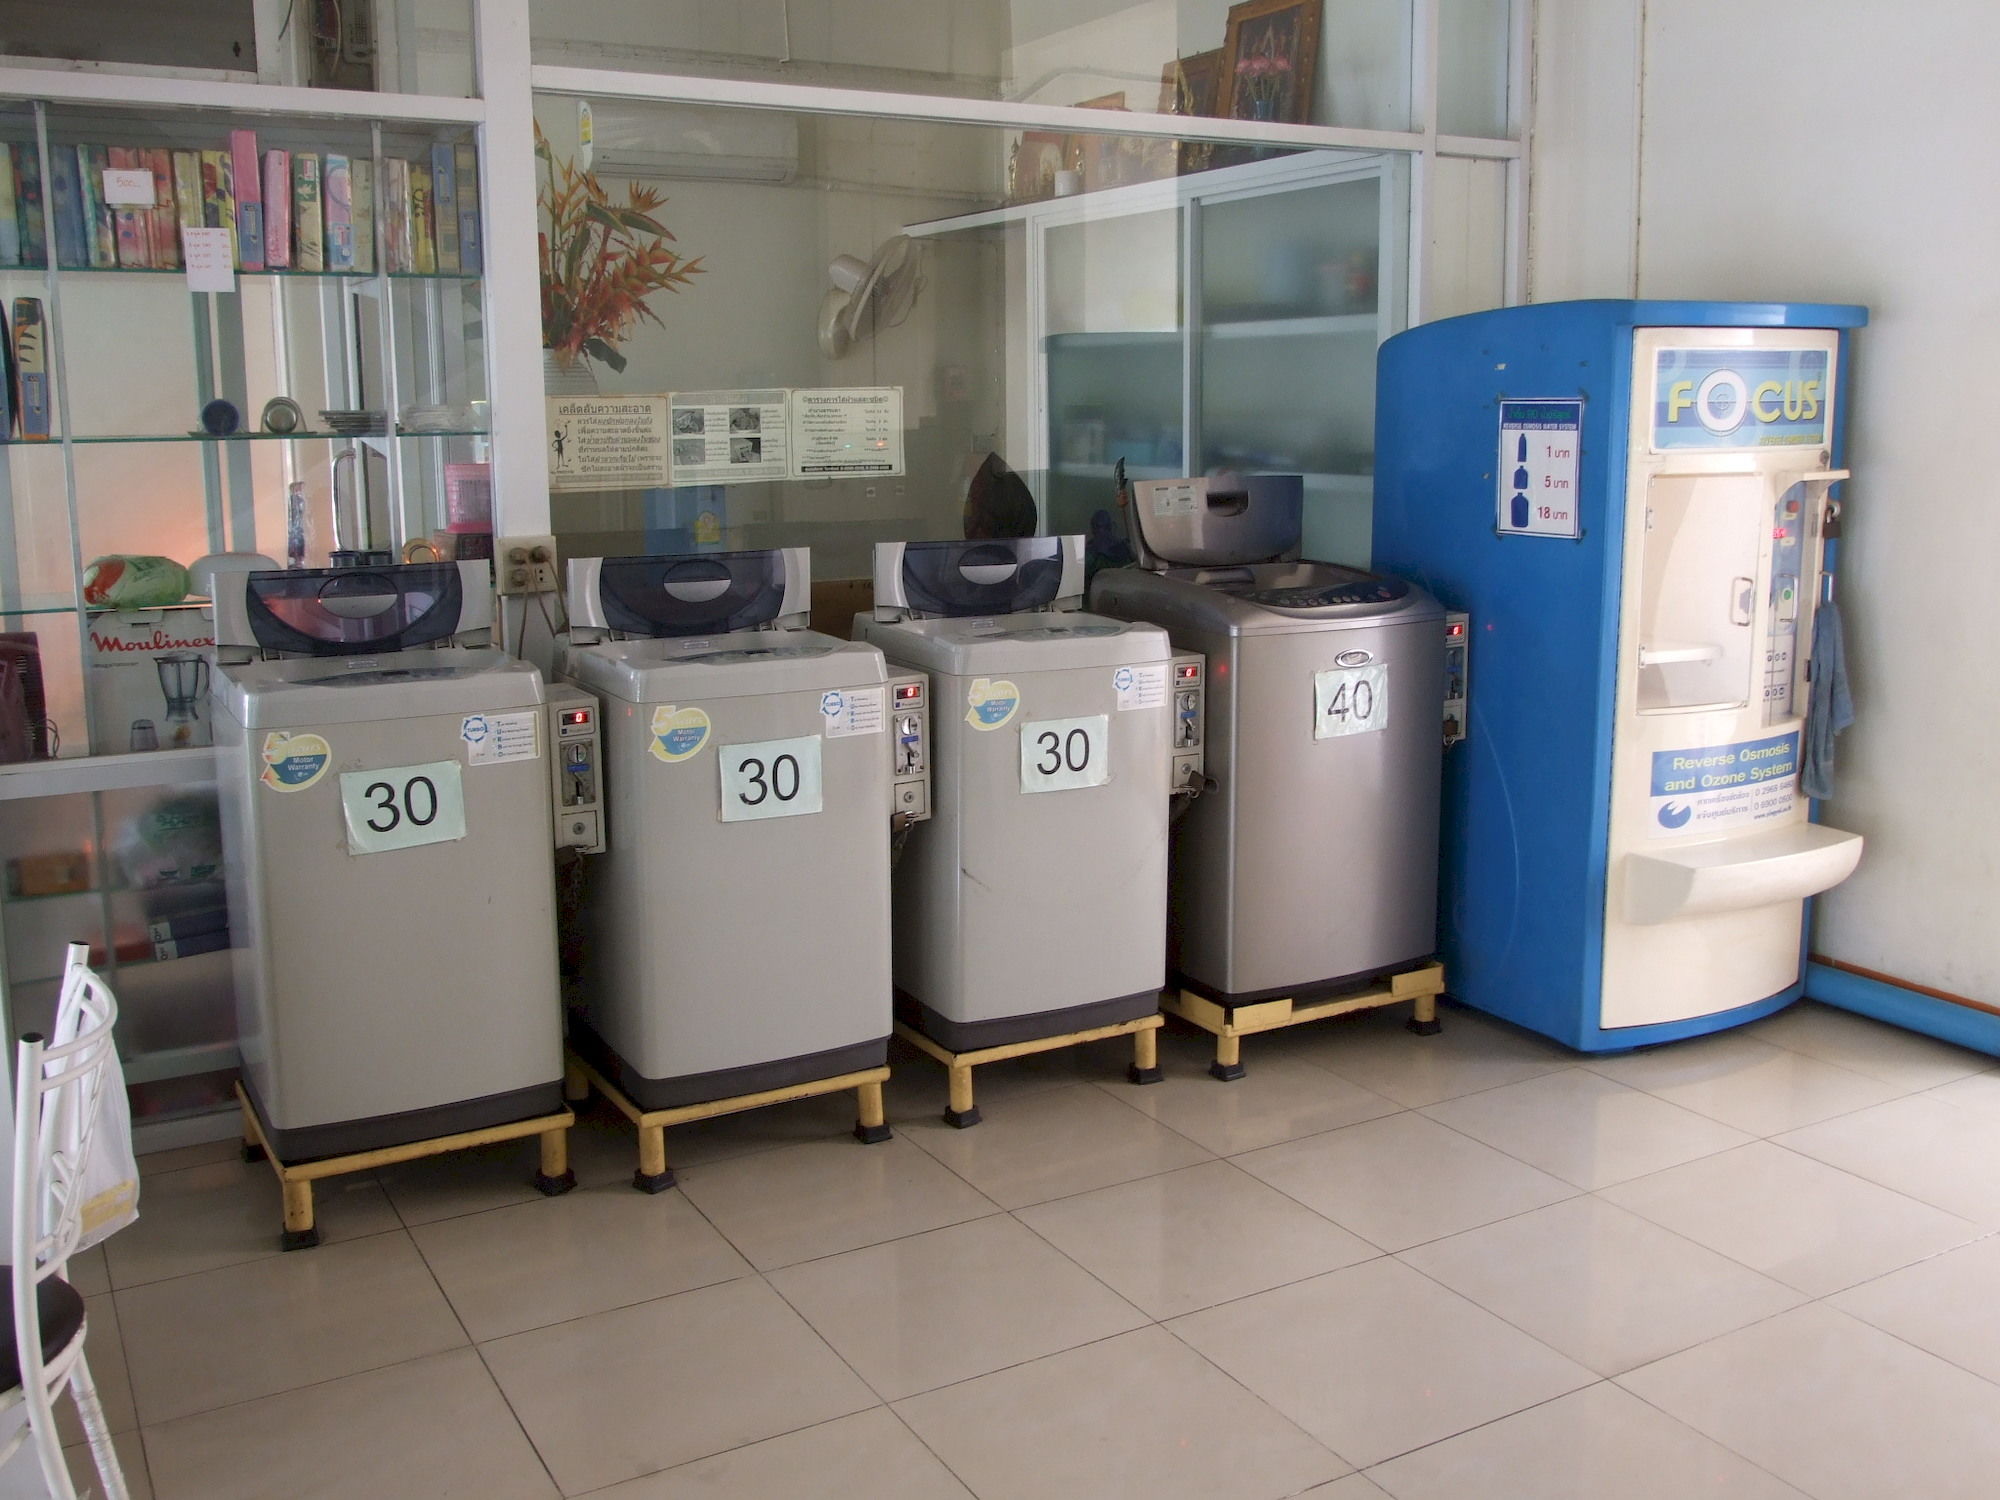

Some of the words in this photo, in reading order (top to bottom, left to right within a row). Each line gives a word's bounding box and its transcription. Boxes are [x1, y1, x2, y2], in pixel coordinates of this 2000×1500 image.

[1668, 368, 1819, 433] FOCUS
[1547, 445, 1552, 458] 1
[1554, 449, 1570, 458] บาท
[1545, 475, 1551, 488] 5
[1553, 479, 1569, 488] บาท
[1537, 506, 1551, 519] 18
[1553, 511, 1568, 520] บาท
[90, 630, 217, 652] Moulinex
[1186, 668, 1192, 676] 0
[907, 687, 914, 697] 0
[1328, 680, 1373, 722] 40
[575, 712, 583, 723] 0
[1037, 728, 1090, 775] 30
[1672, 754, 1736, 770] Reverse
[1739, 742, 1791, 761] Osmosis
[287, 763, 320, 771] Warranty
[1664, 777, 1696, 791] and
[1701, 772, 1746, 787] Ozone
[1750, 761, 1793, 781] System
[738, 754, 800, 805] 30
[364, 776, 437, 832] 30
